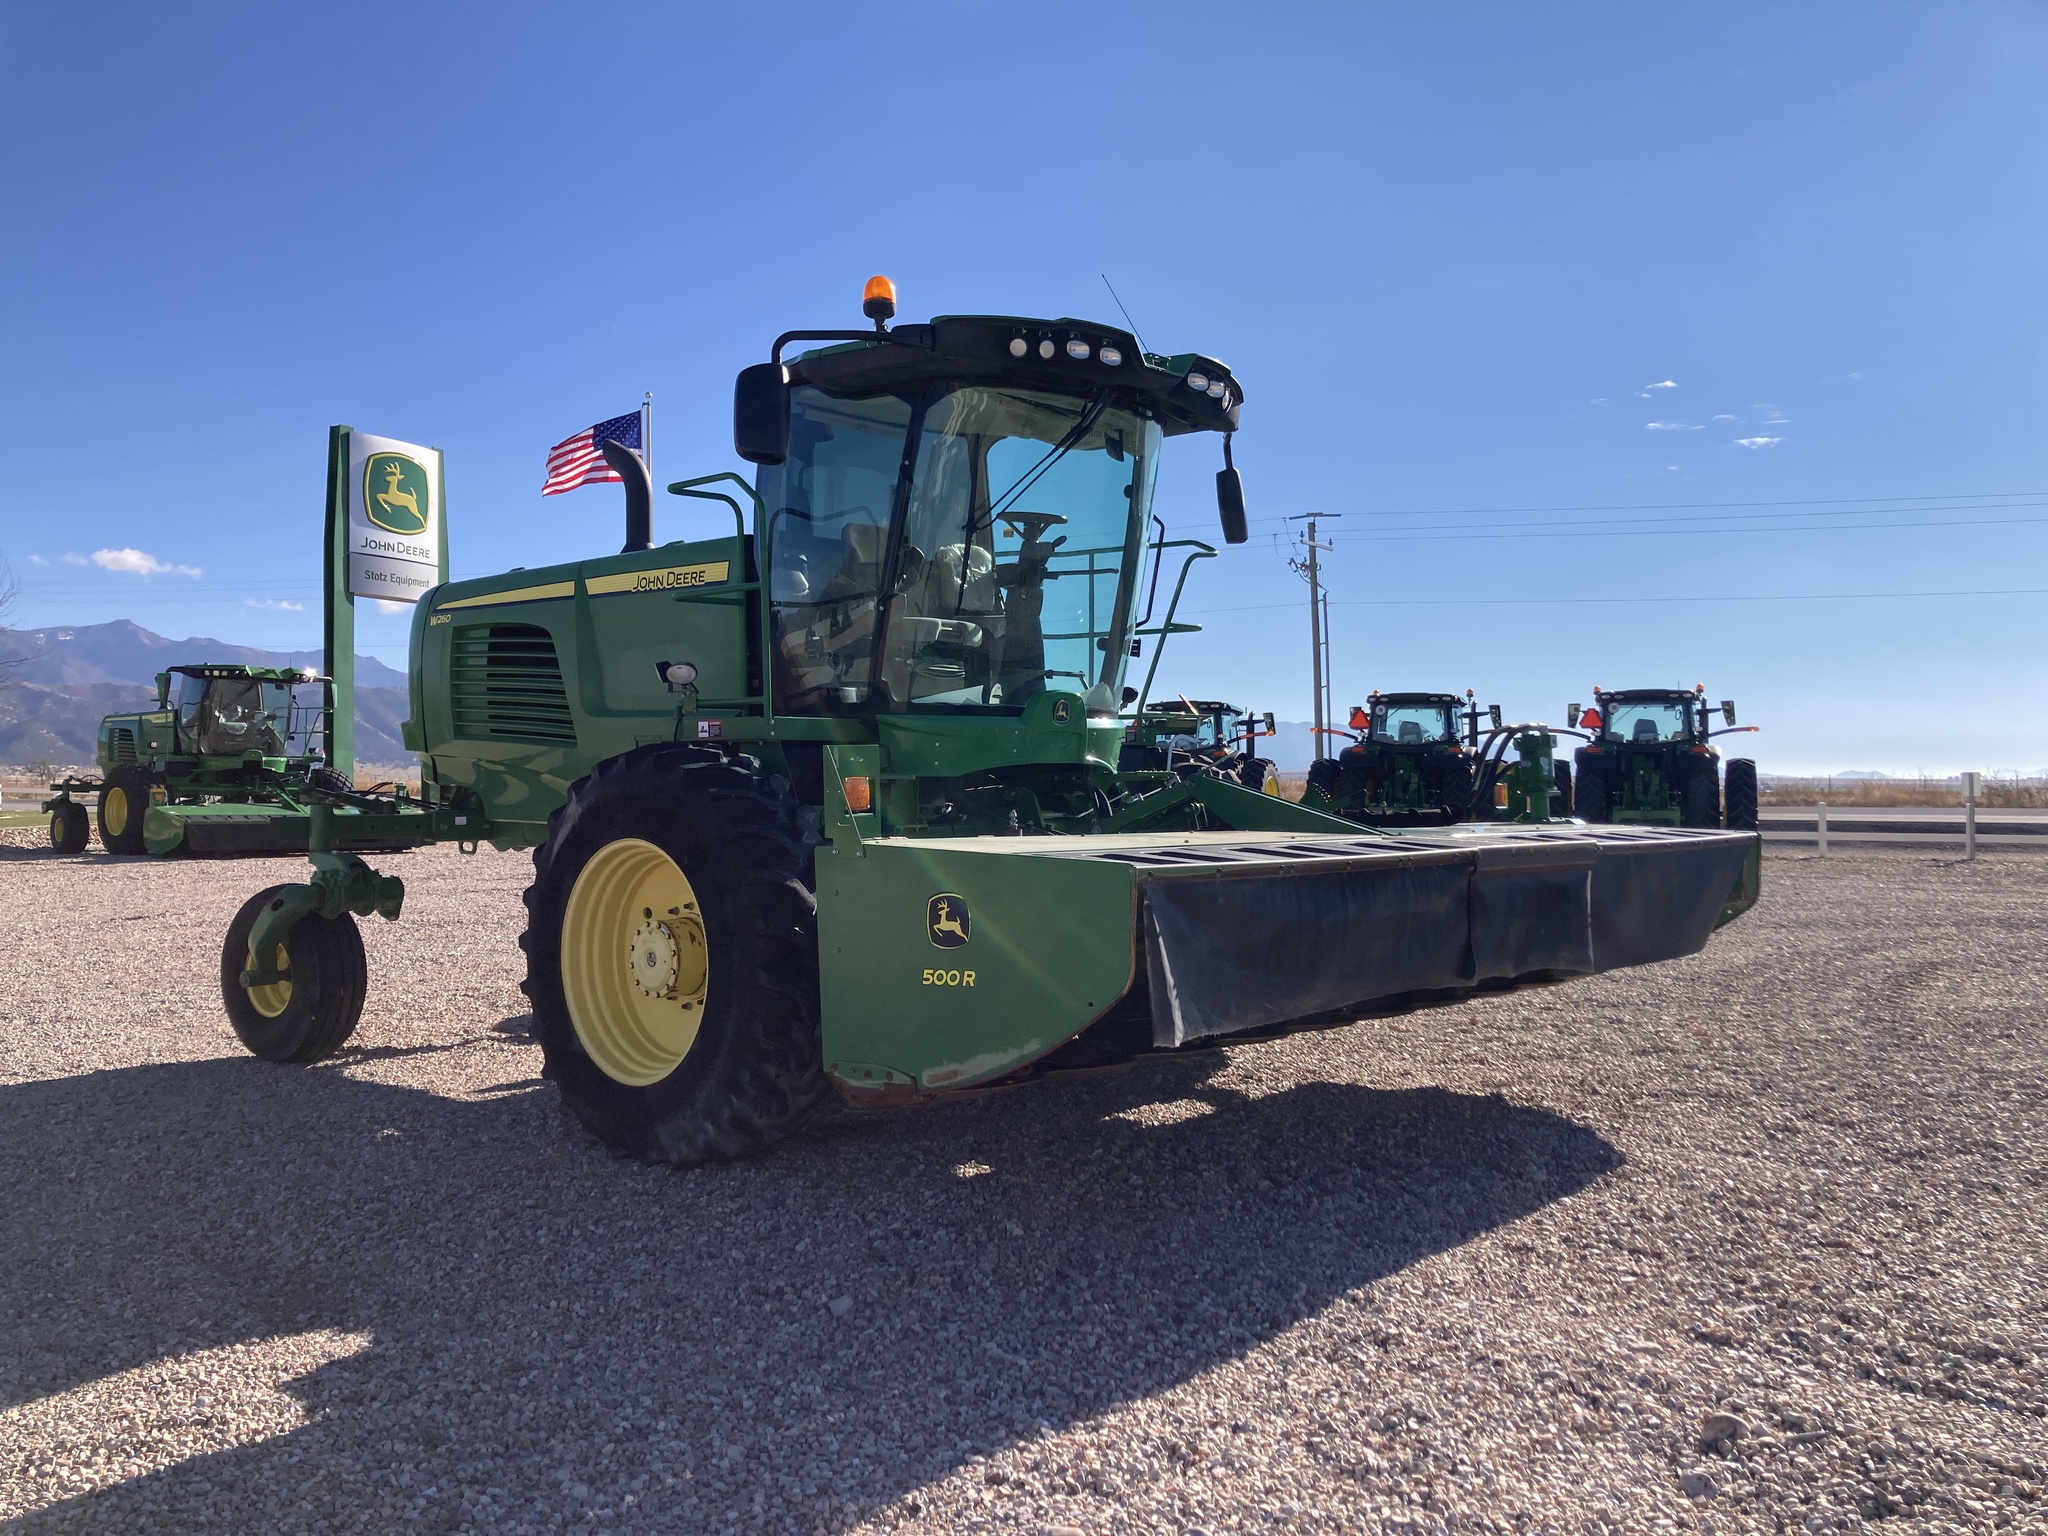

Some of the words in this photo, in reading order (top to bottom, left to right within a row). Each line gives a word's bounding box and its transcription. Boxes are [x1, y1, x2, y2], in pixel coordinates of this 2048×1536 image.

[361, 537, 395, 552] JOHN
[397, 542, 430, 558] DEERE
[364, 570, 387, 582] Stotz
[390, 573, 430, 588] Equipment
[632, 575, 664, 590] JOHN
[666, 570, 706, 586] DEERE
[430, 614, 451, 626] W260
